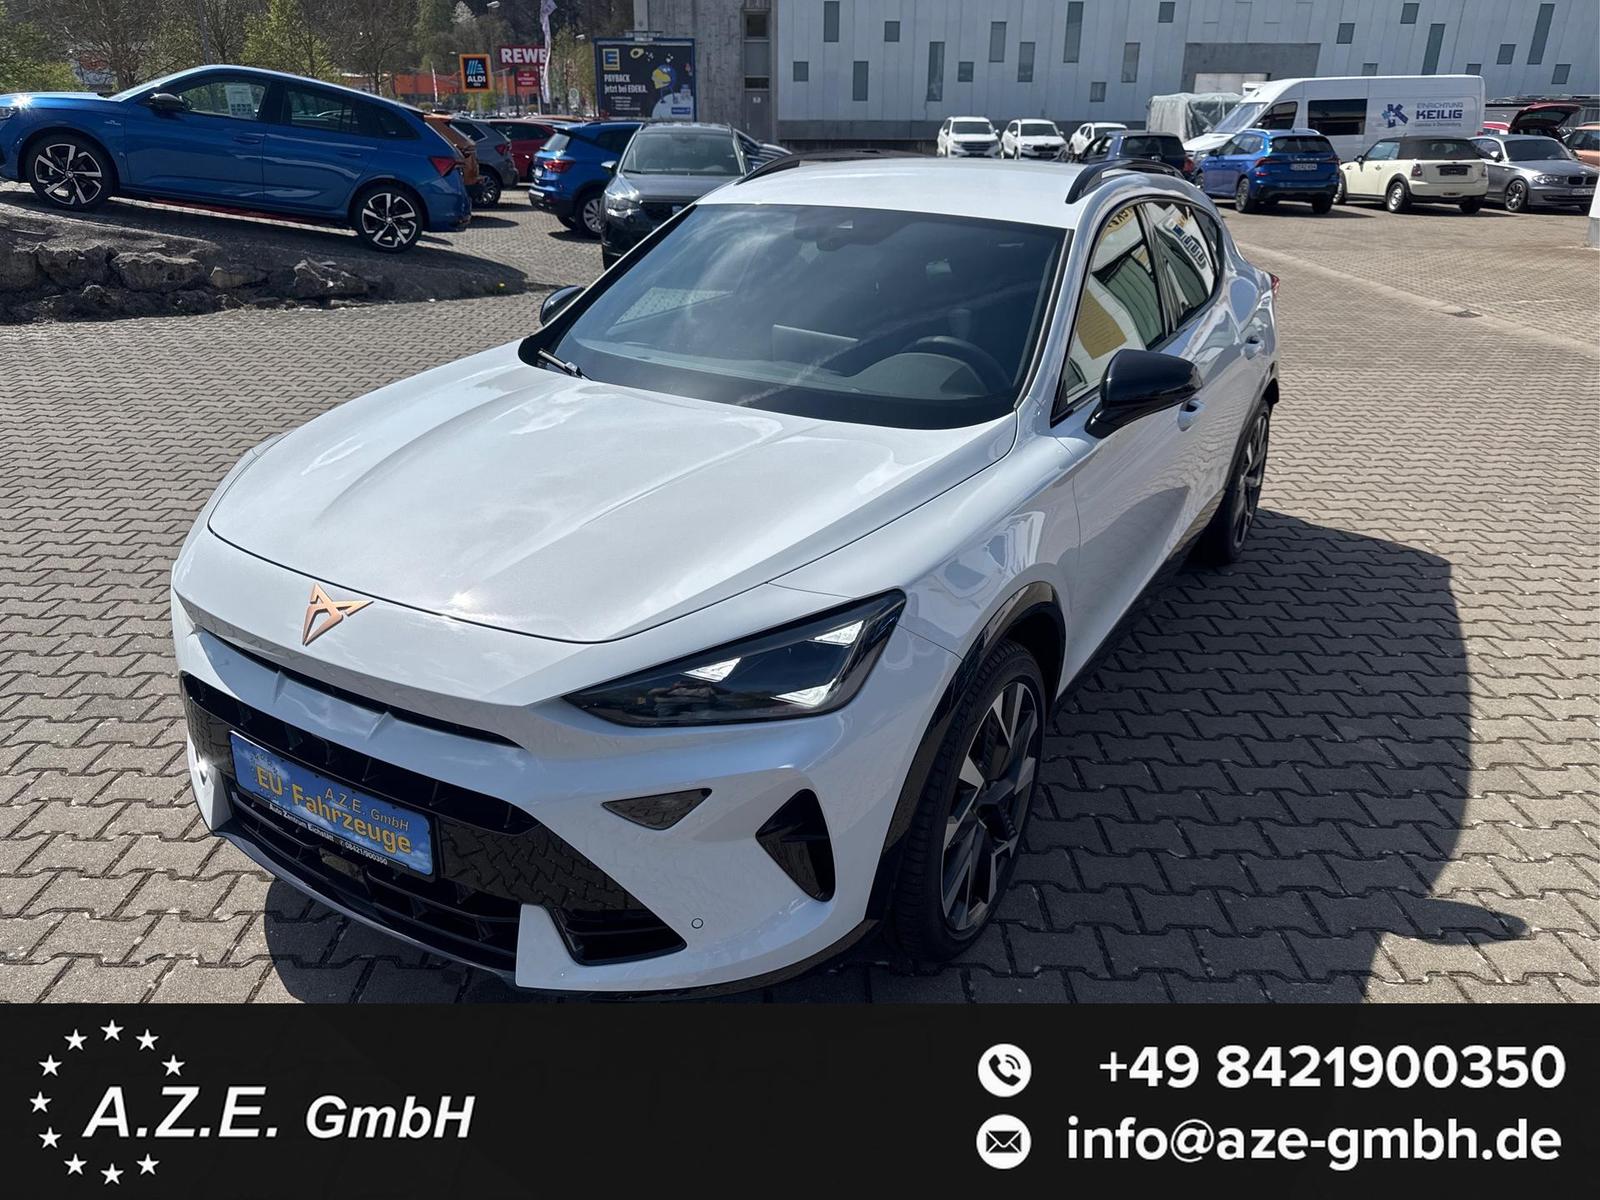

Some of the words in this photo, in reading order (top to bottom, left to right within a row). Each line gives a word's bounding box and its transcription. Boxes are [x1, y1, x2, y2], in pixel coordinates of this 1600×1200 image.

[500, 48, 546, 63] REWE
[604, 74, 631, 83] PAYBACK
[1416, 109, 1463, 120] KEILIG
[370, 808, 409, 832] GmbH
